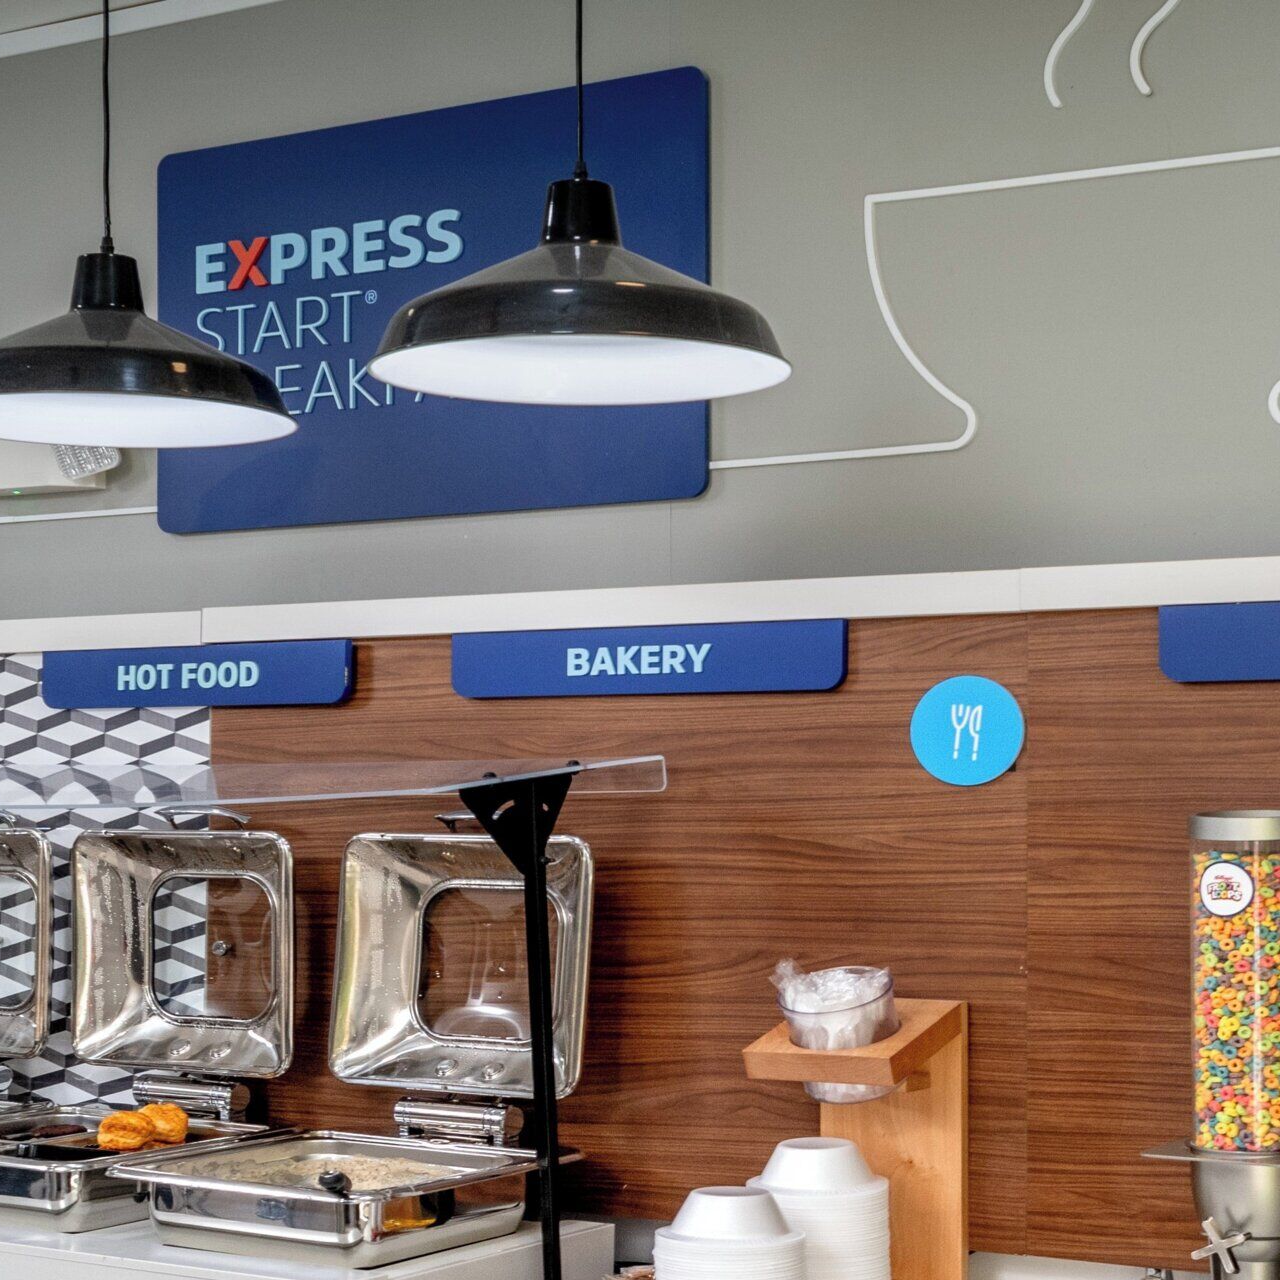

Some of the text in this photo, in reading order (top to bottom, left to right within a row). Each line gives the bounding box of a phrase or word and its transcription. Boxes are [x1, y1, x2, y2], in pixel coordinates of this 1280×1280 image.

[195, 208, 464, 294] EXPRESS
[117, 661, 260, 691] HOT FOOD
[566, 643, 712, 677] BAKERY
